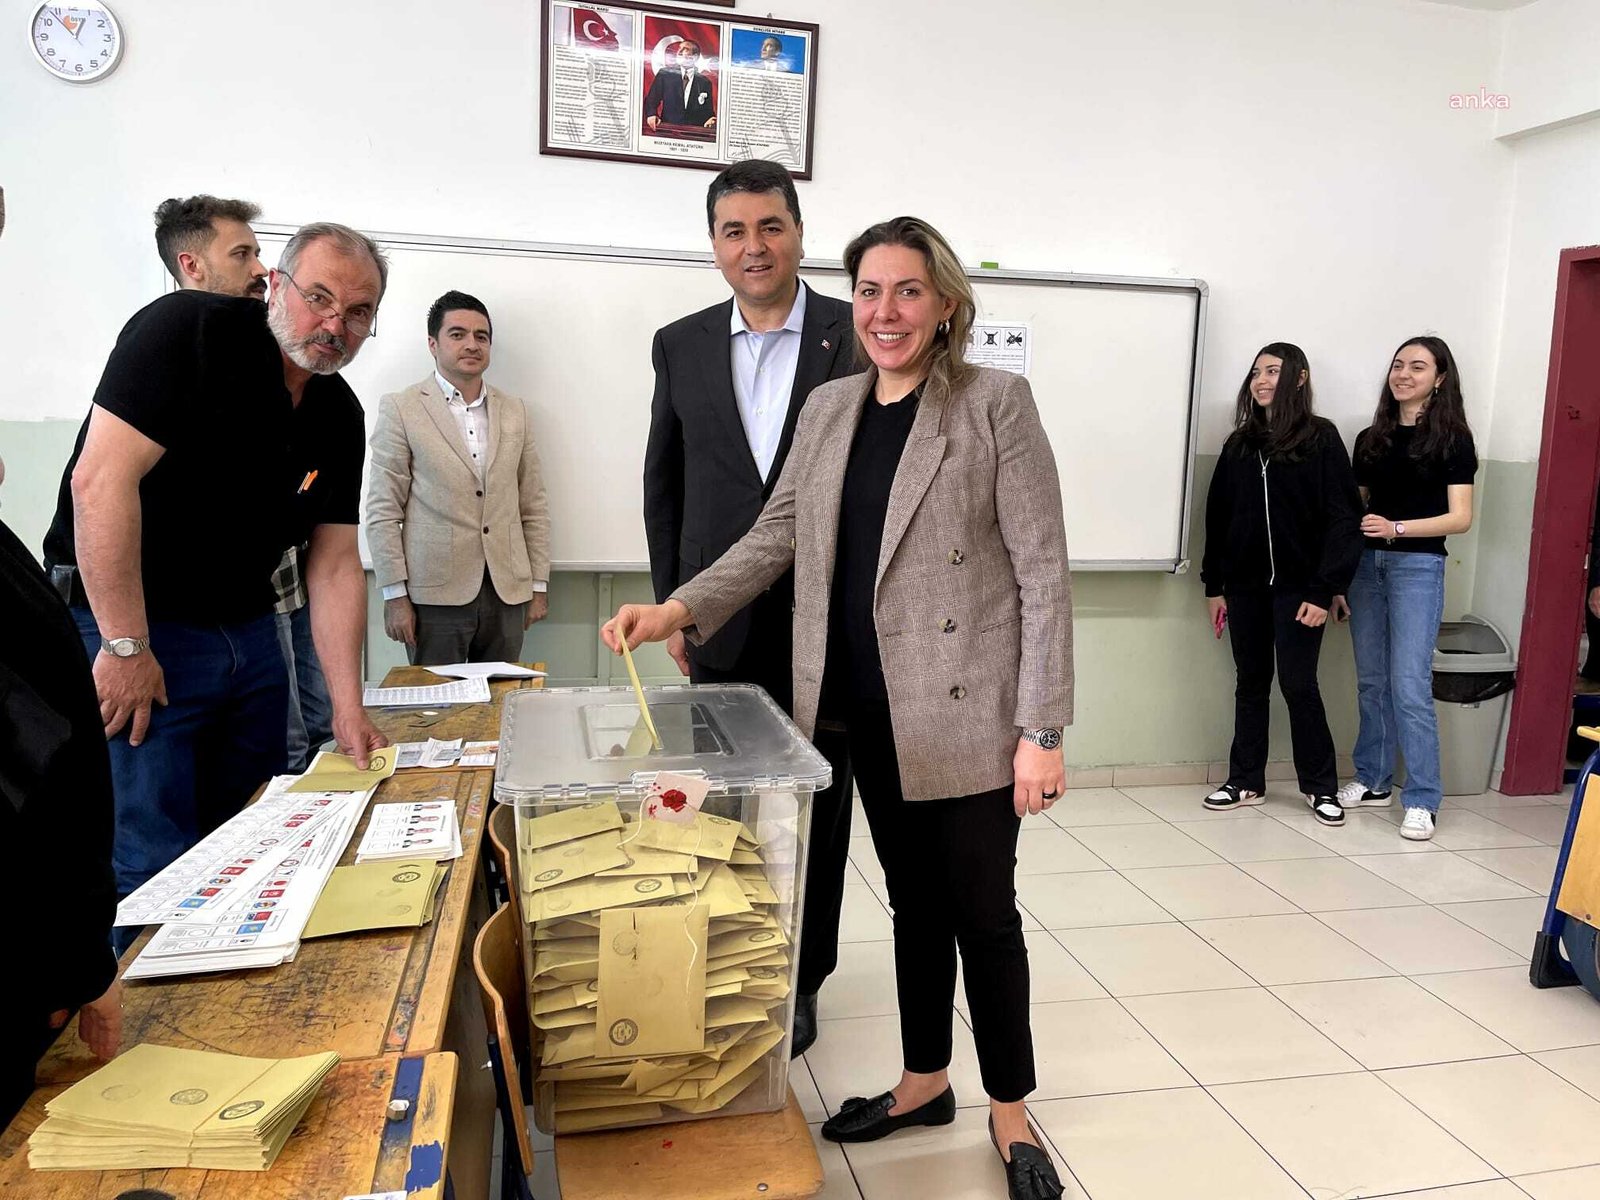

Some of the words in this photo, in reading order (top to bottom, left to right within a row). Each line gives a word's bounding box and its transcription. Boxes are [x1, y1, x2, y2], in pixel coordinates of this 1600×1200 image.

[54, 7, 62, 15] 11
[43, 18, 53, 26] 10
[97, 19, 106, 28] 2
[40, 33, 49, 41] 9
[103, 34, 112, 43] 3
[46, 48, 56, 56] 8
[100, 49, 108, 57] 4
[59, 59, 67, 68] 7
[90, 60, 98, 68] 5
[75, 64, 83, 72] 6
